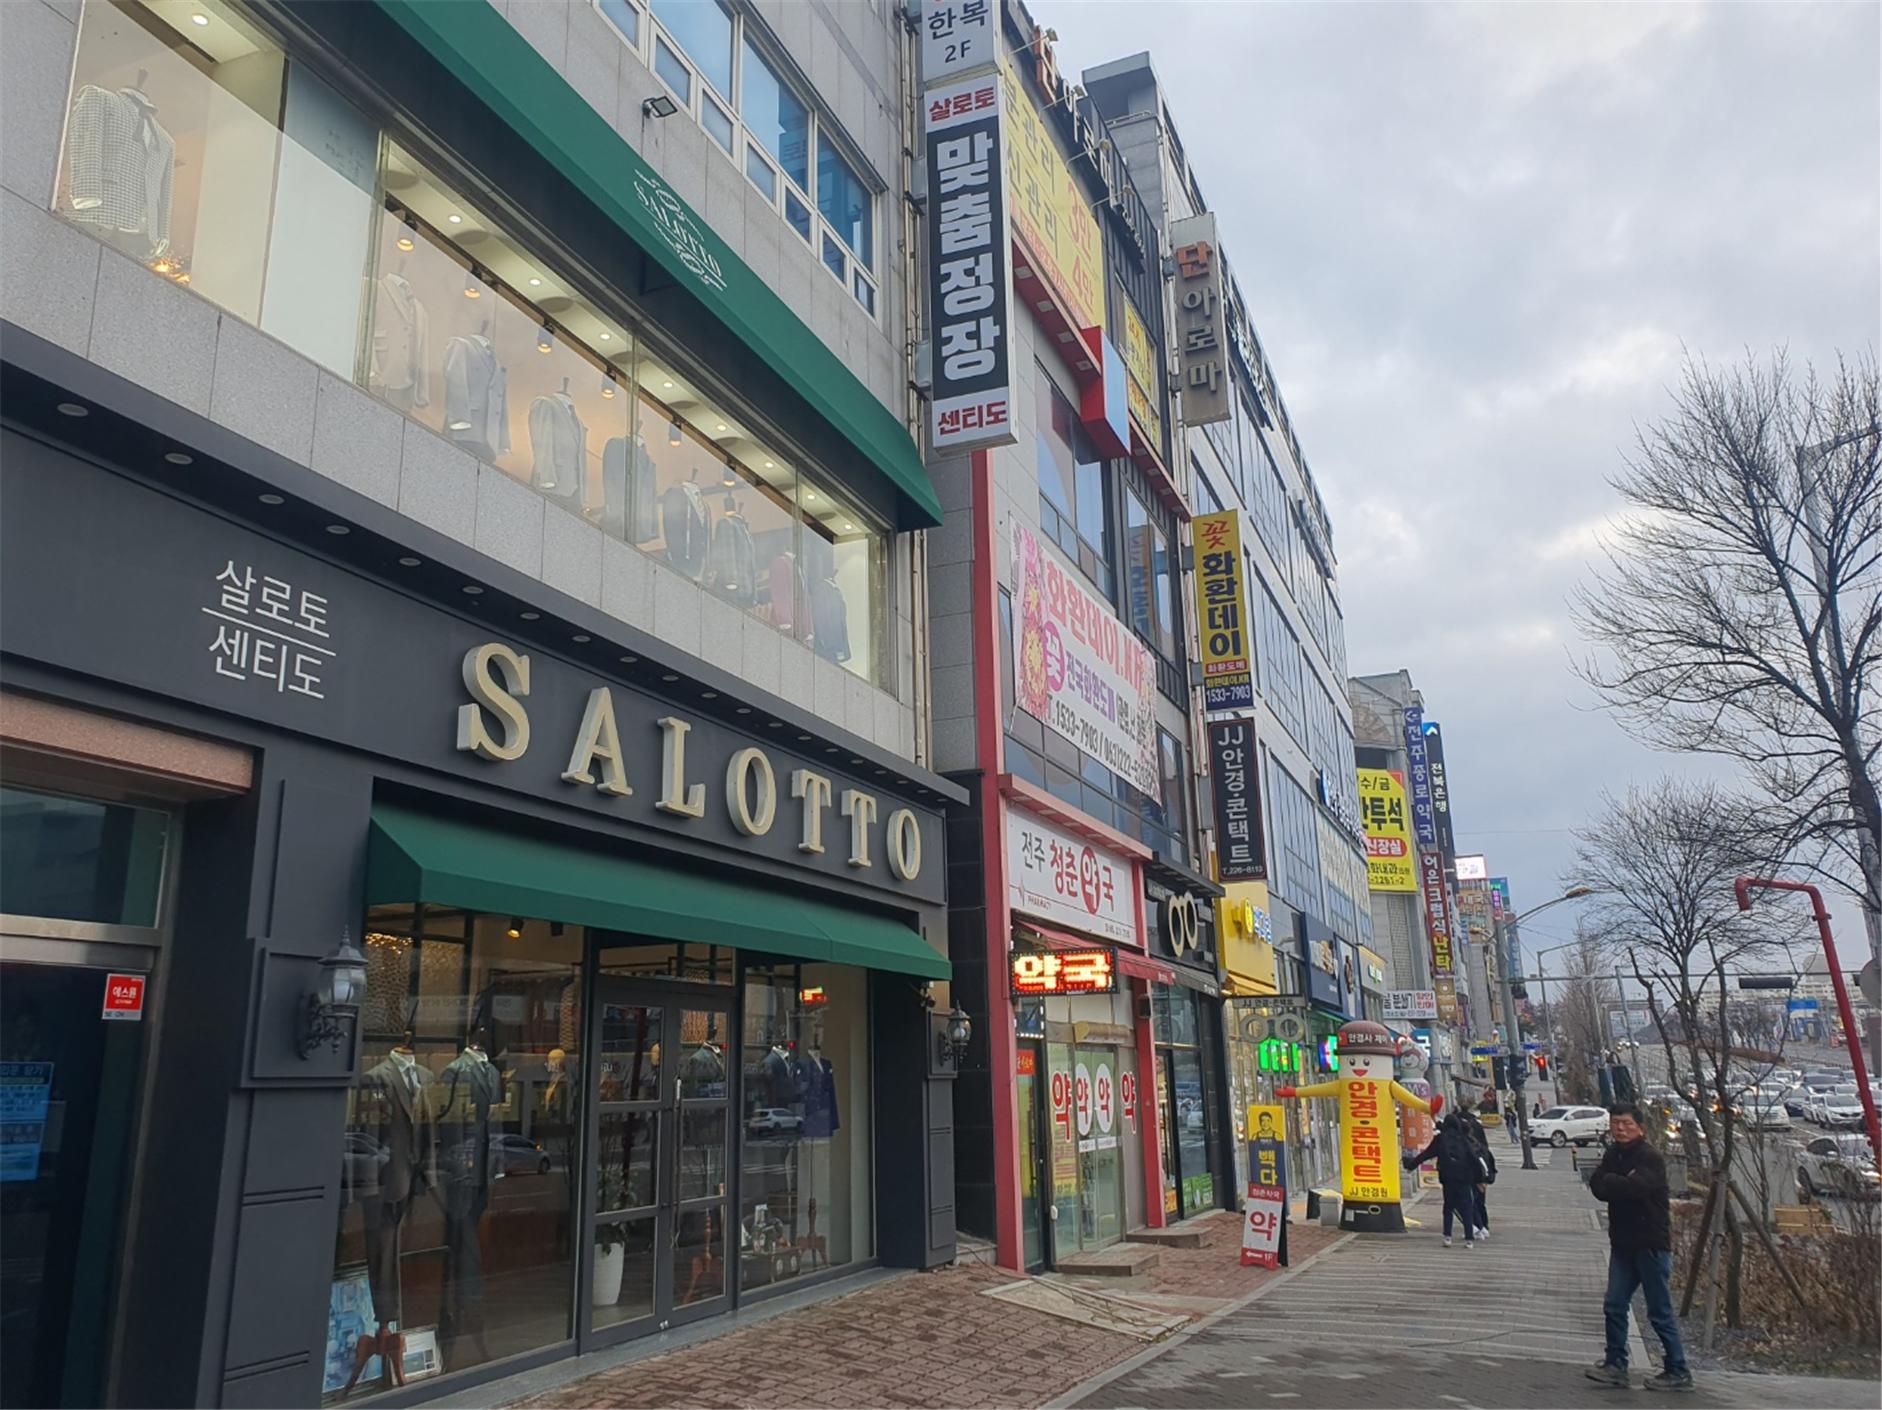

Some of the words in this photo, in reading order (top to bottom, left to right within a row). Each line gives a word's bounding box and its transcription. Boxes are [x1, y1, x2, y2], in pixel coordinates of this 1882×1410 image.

[928, 0, 988, 40] 한복
[945, 40, 971, 62] 2F
[929, 87, 995, 122] 살로토
[937, 131, 999, 381] 맞춤정장
[1177, 241, 1221, 392] 단아로마
[938, 401, 1008, 437] 센티도
[1201, 521, 1230, 549] 꽃
[216, 560, 331, 638] 살로토
[1203, 550, 1241, 656] 화환데이
[208, 626, 324, 699] 센티도
[1206, 685, 1250, 703] 1533-7903
[1218, 726, 1243, 746] JJ
[457, 642, 922, 881] SALOTTO
[1431, 763, 1447, 812] 전북은행
[1022, 831, 1045, 872] 전주
[1050, 839, 1114, 914] 청춘약국
[1014, 953, 1111, 990] 약국
[1053, 1072, 1072, 1141] 약
[1076, 1077, 1089, 1125] 약
[1098, 1077, 1110, 1124] 약
[1121, 1072, 1137, 1135] 약
[1250, 1211, 1277, 1241] 약
